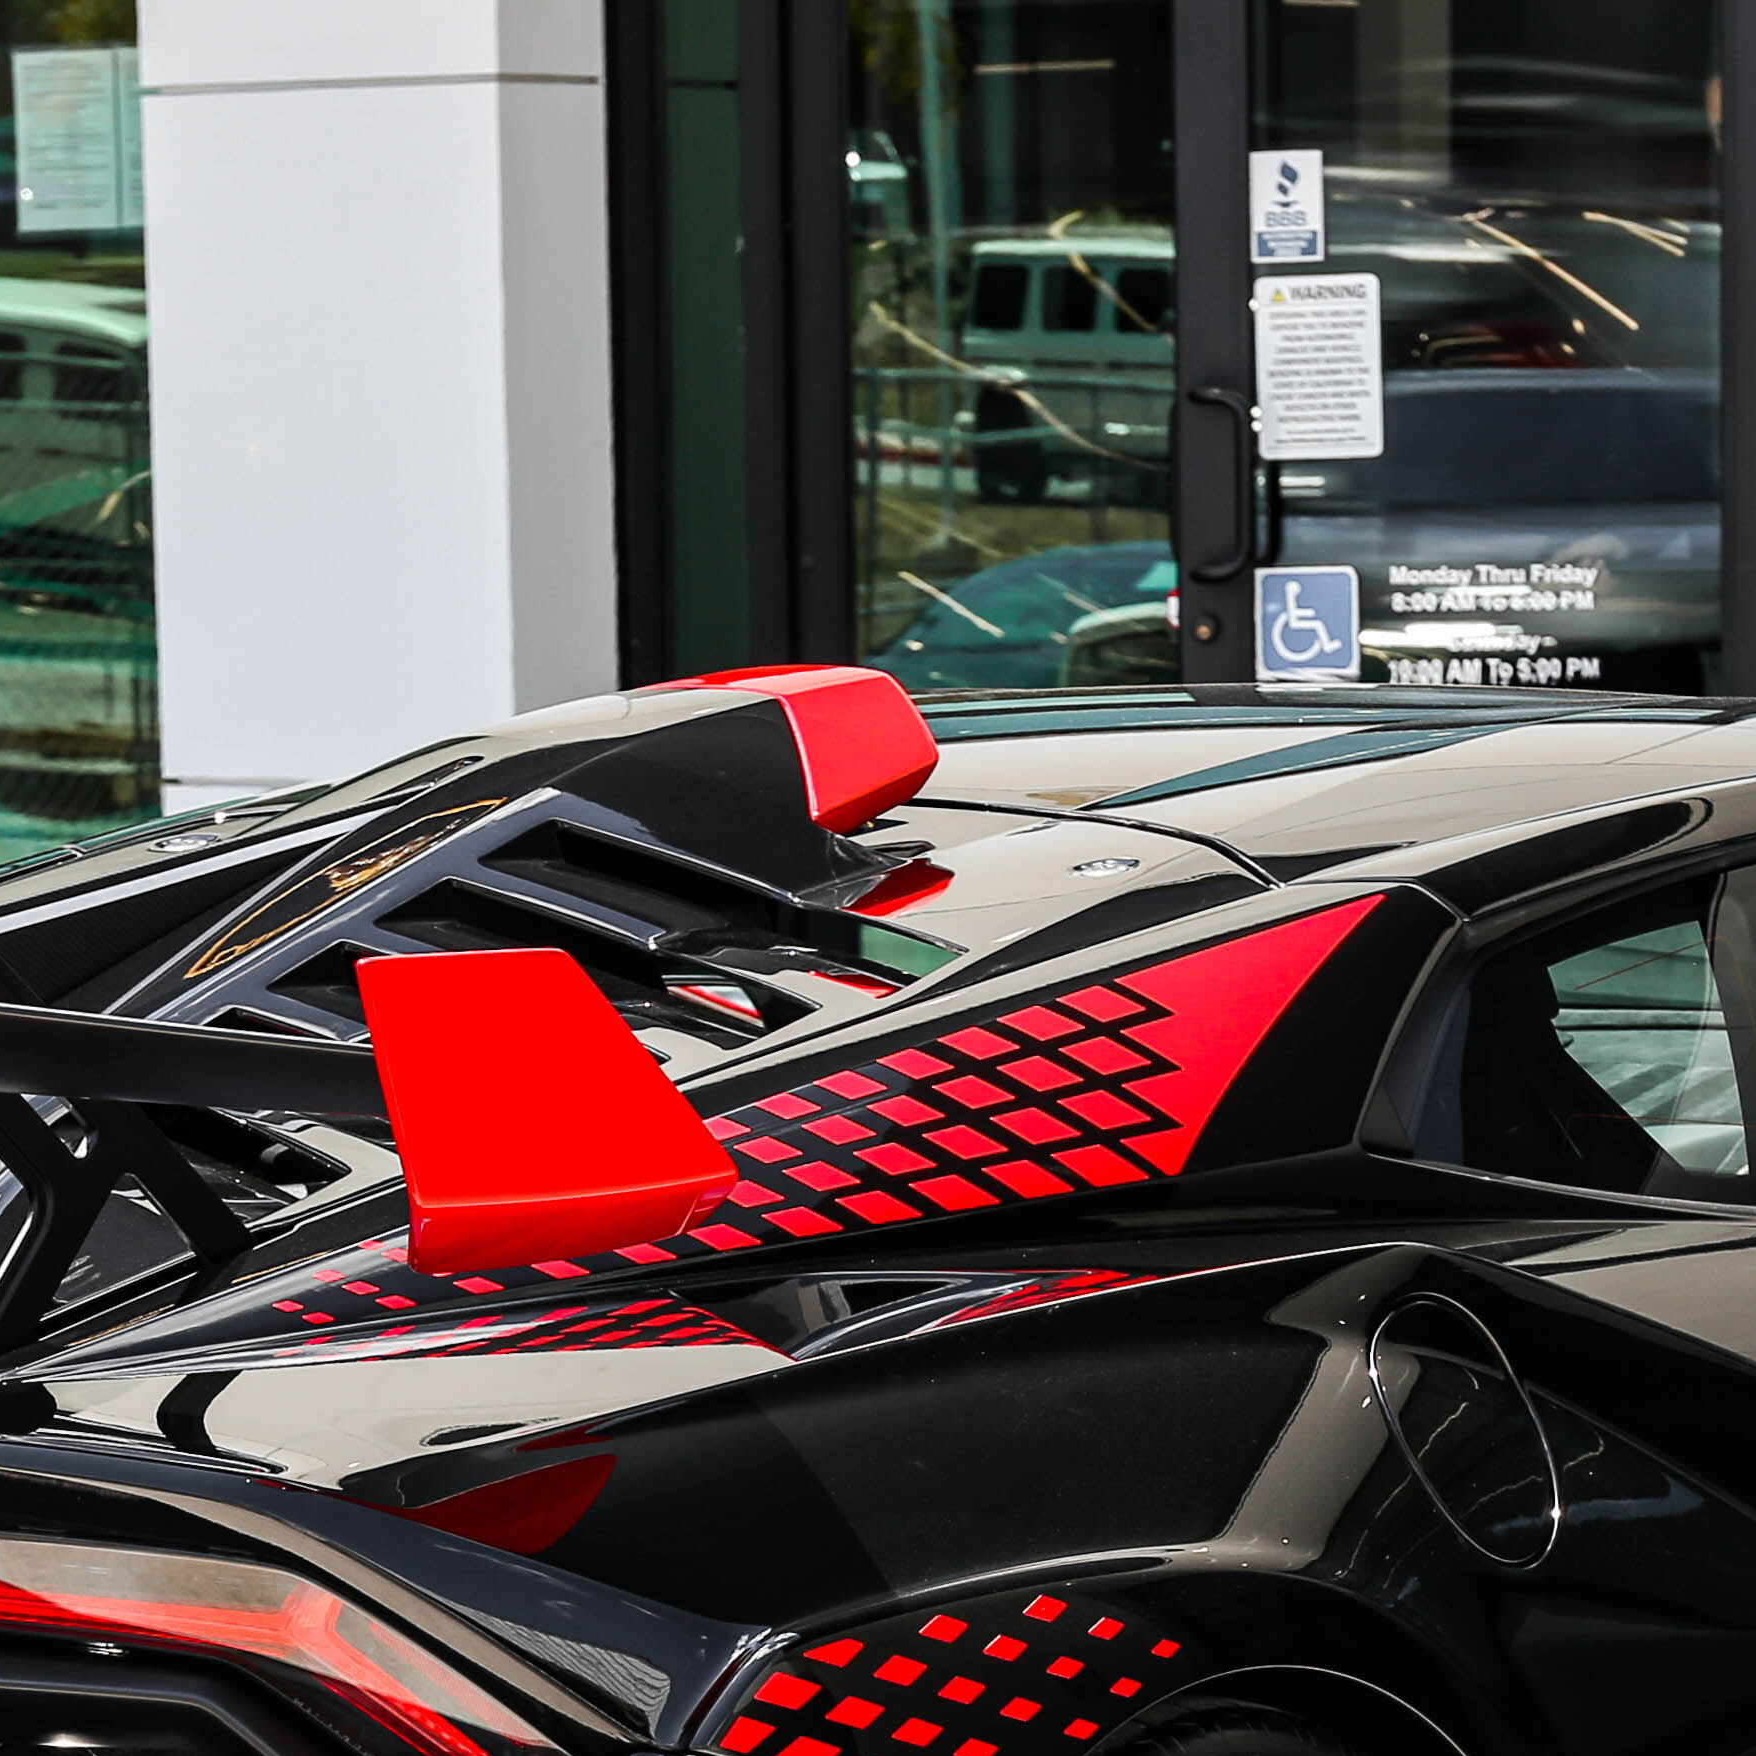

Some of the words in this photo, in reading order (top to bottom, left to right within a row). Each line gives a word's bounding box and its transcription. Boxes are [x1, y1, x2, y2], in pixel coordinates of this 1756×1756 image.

[1289, 284, 1367, 300] WARNING
[1388, 565, 1473, 586] Monday
[1474, 564, 1526, 584] Thru
[1529, 564, 1599, 588] Friday
[1439, 591, 1476, 612] AM
[1560, 590, 1595, 610] PM
[1446, 658, 1483, 684] AM
[1485, 658, 1514, 685] To
[1565, 658, 1600, 681] PM
